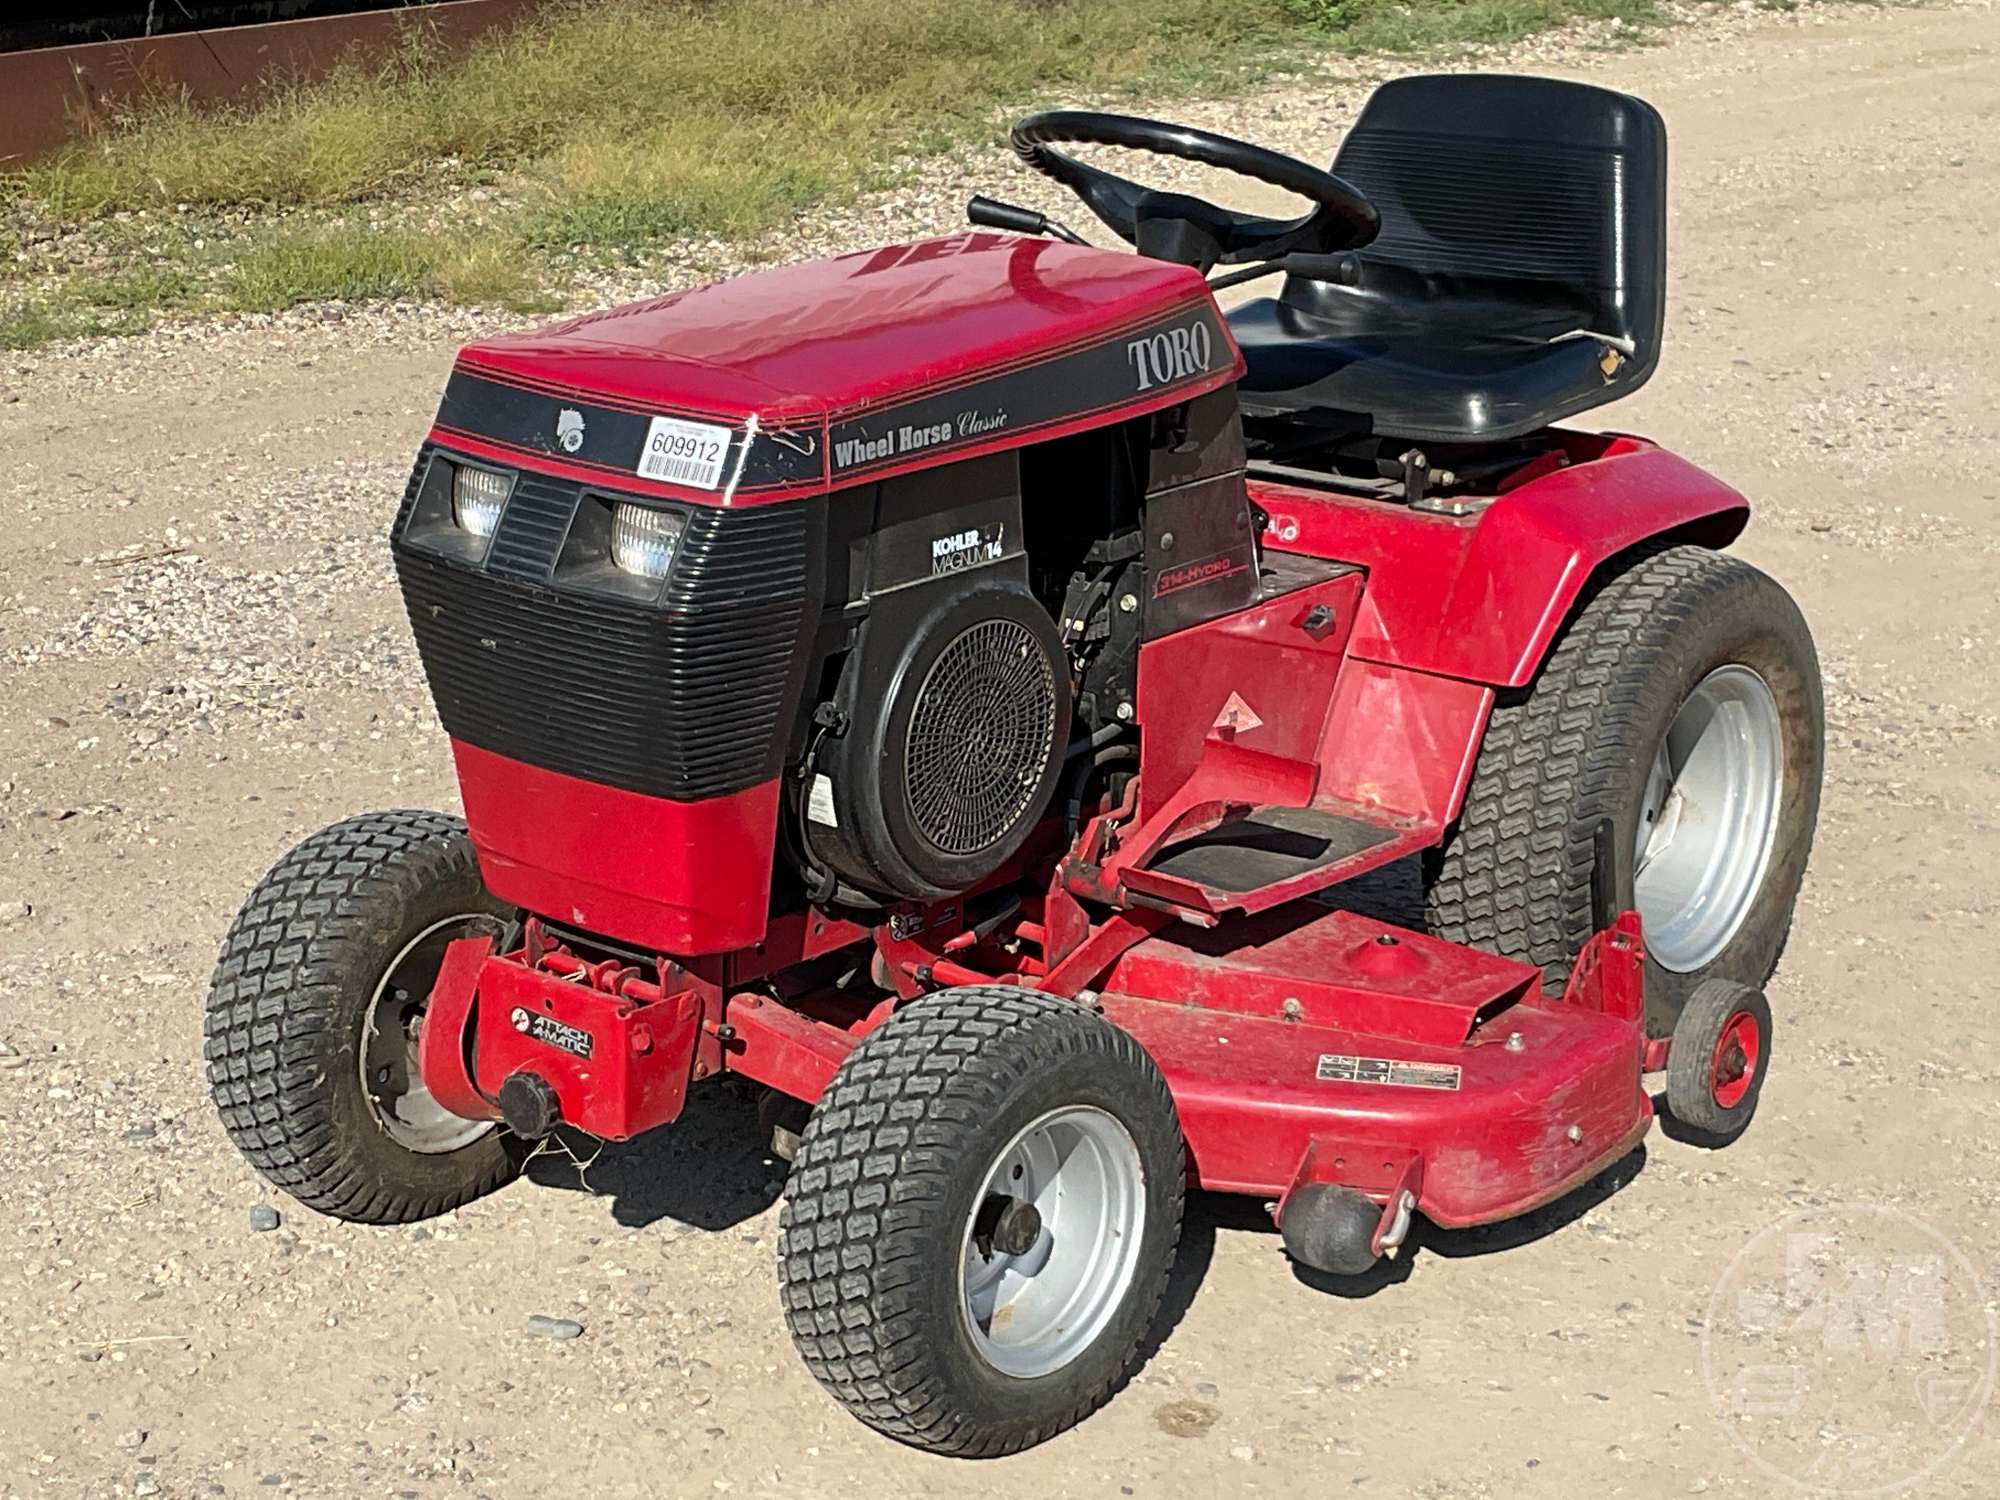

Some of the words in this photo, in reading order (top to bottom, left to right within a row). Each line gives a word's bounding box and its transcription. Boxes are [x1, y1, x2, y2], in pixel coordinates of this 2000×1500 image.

[651, 432, 720, 463] 609912
[835, 430, 894, 468] Wheel
[899, 421, 952, 452] Horse
[956, 407, 1008, 437] Classic
[534, 1016, 588, 1043] ATTACH
